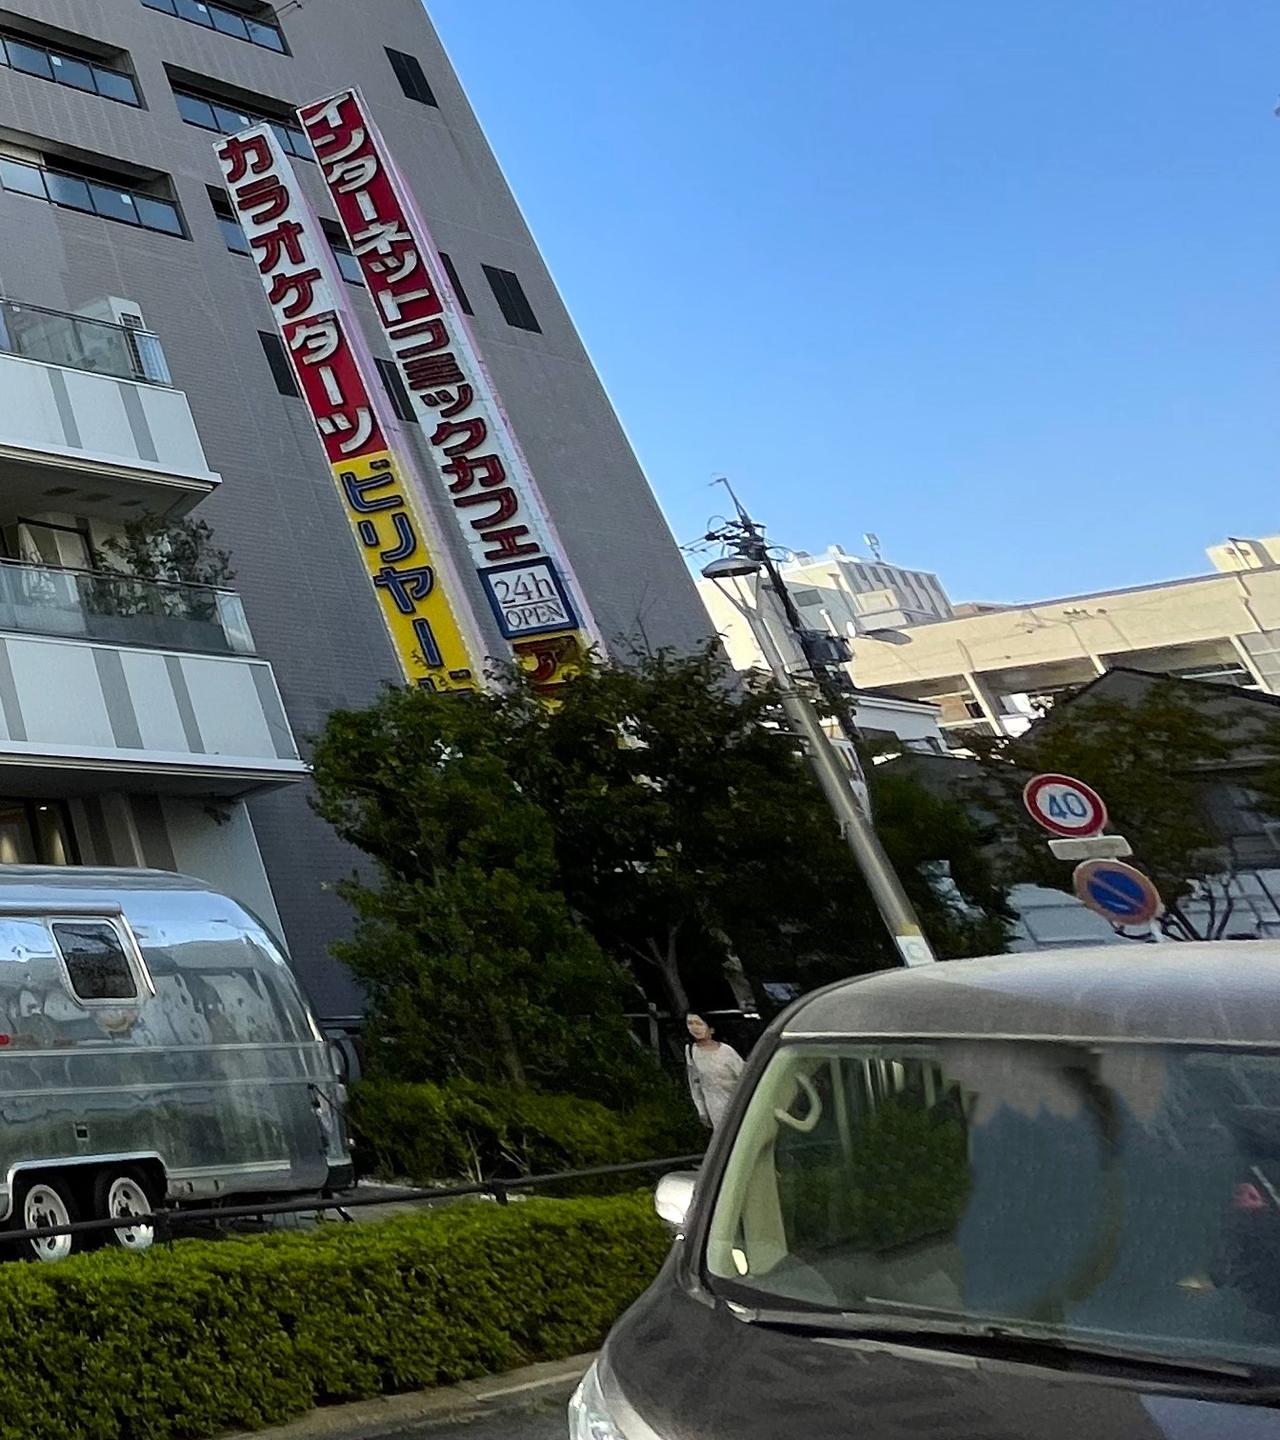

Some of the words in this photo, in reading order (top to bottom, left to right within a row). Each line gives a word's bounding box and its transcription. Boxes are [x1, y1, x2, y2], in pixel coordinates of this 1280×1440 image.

[219, 135, 321, 319] カラオケ
[289, 316, 375, 455] ダーツ
[305, 93, 432, 321] インターネット
[388, 319, 540, 560] コミックカフェ
[494, 571, 557, 604] 24h
[505, 601, 565, 628] OPEN
[1048, 792, 1087, 819] 40
